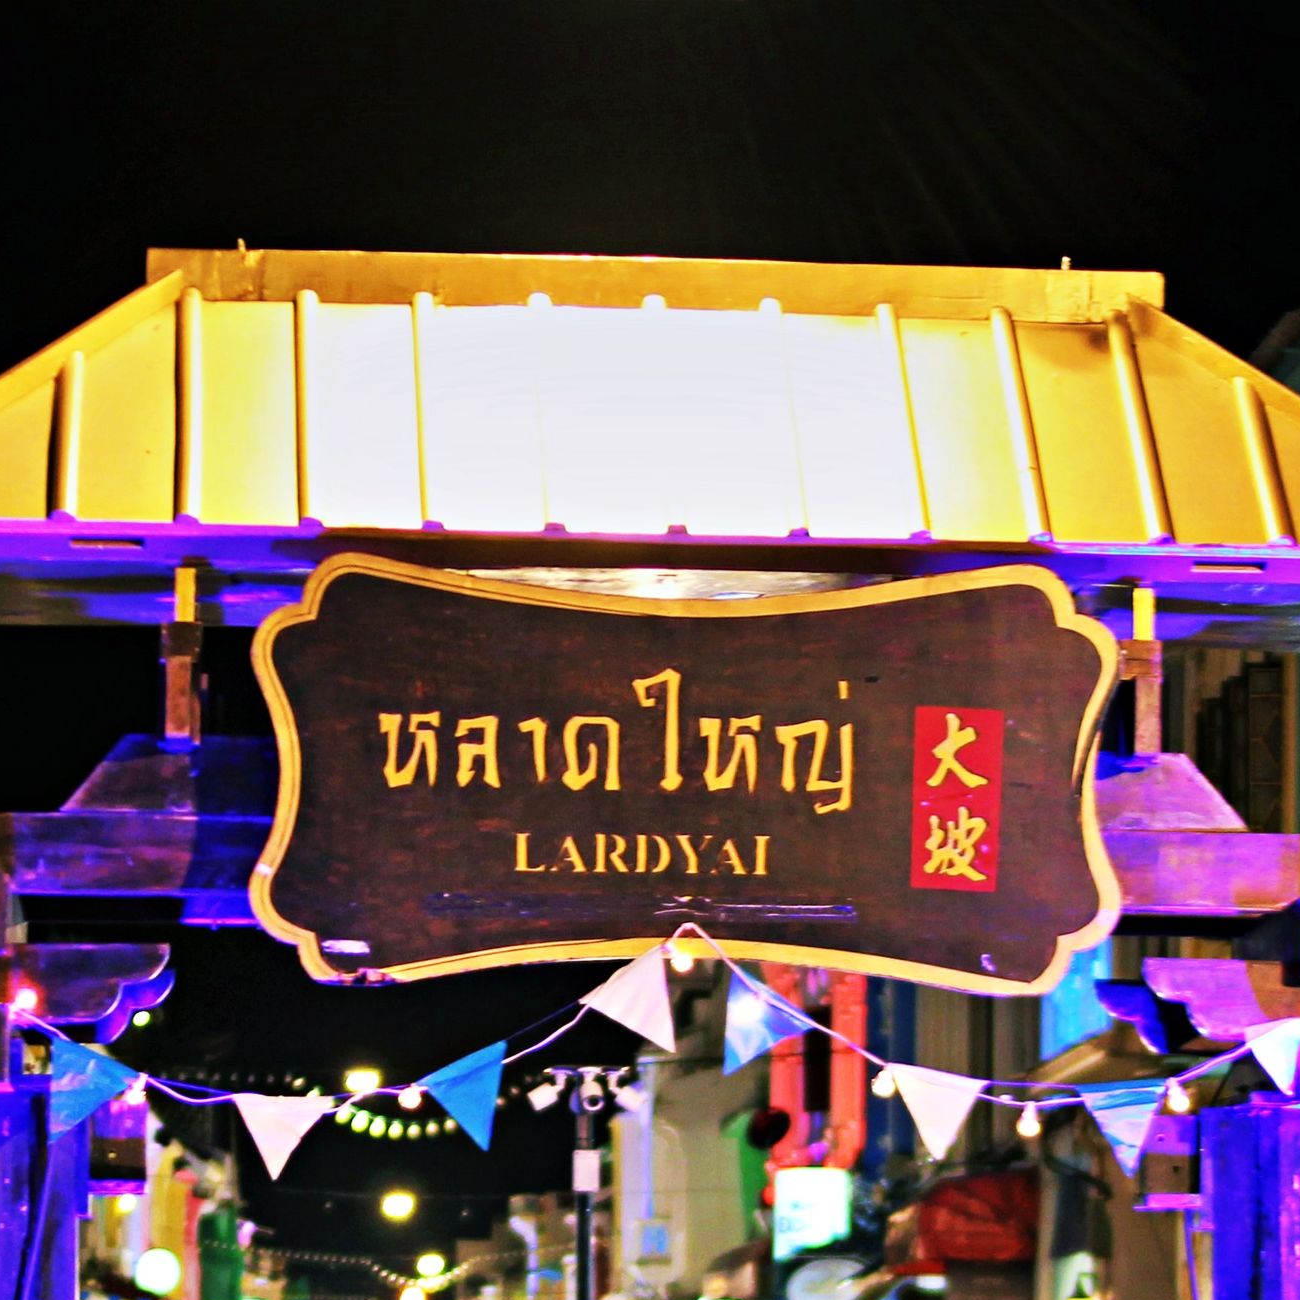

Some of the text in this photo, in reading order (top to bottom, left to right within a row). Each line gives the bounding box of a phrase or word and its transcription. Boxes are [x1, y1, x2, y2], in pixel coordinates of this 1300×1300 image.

[378, 667, 855, 814] หลาดใหญ่
[923, 713, 989, 882] 大坡
[513, 832, 771, 877] LARDYAI
